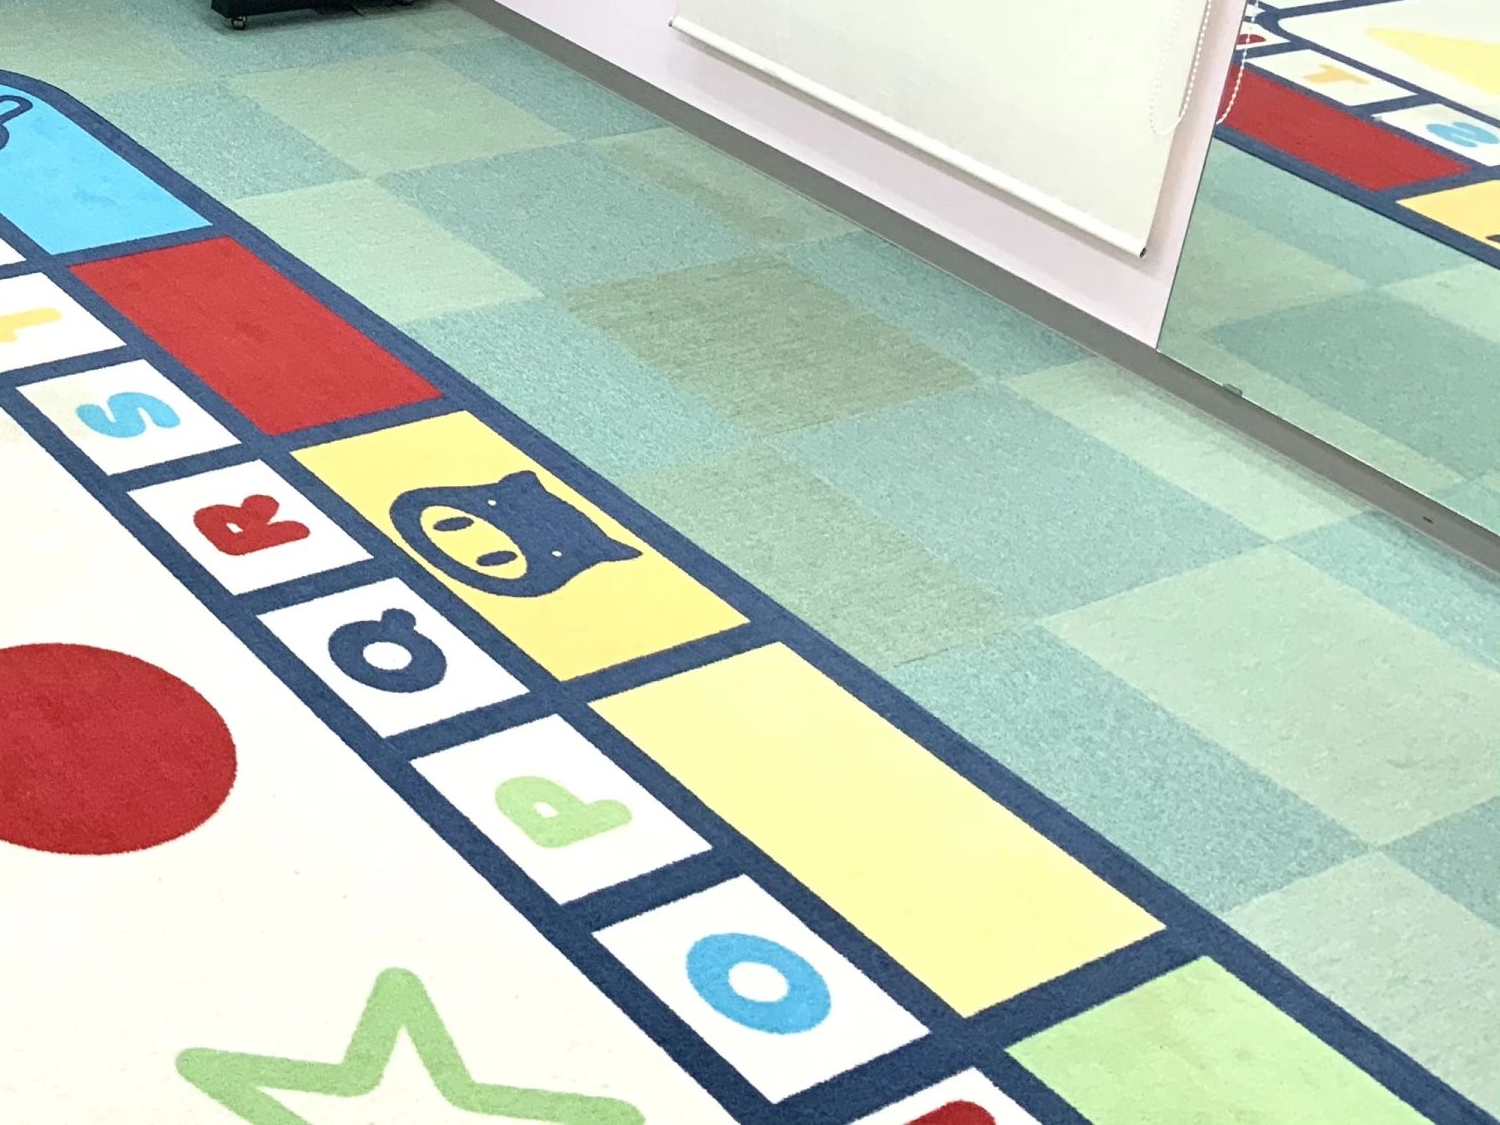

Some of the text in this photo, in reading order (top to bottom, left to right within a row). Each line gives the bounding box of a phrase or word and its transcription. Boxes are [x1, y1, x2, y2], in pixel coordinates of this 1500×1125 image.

[75, 391, 182, 439] S
[194, 494, 311, 557] R
[328, 608, 449, 694] Q
[494, 775, 634, 850] P
[686, 931, 833, 1037] O
